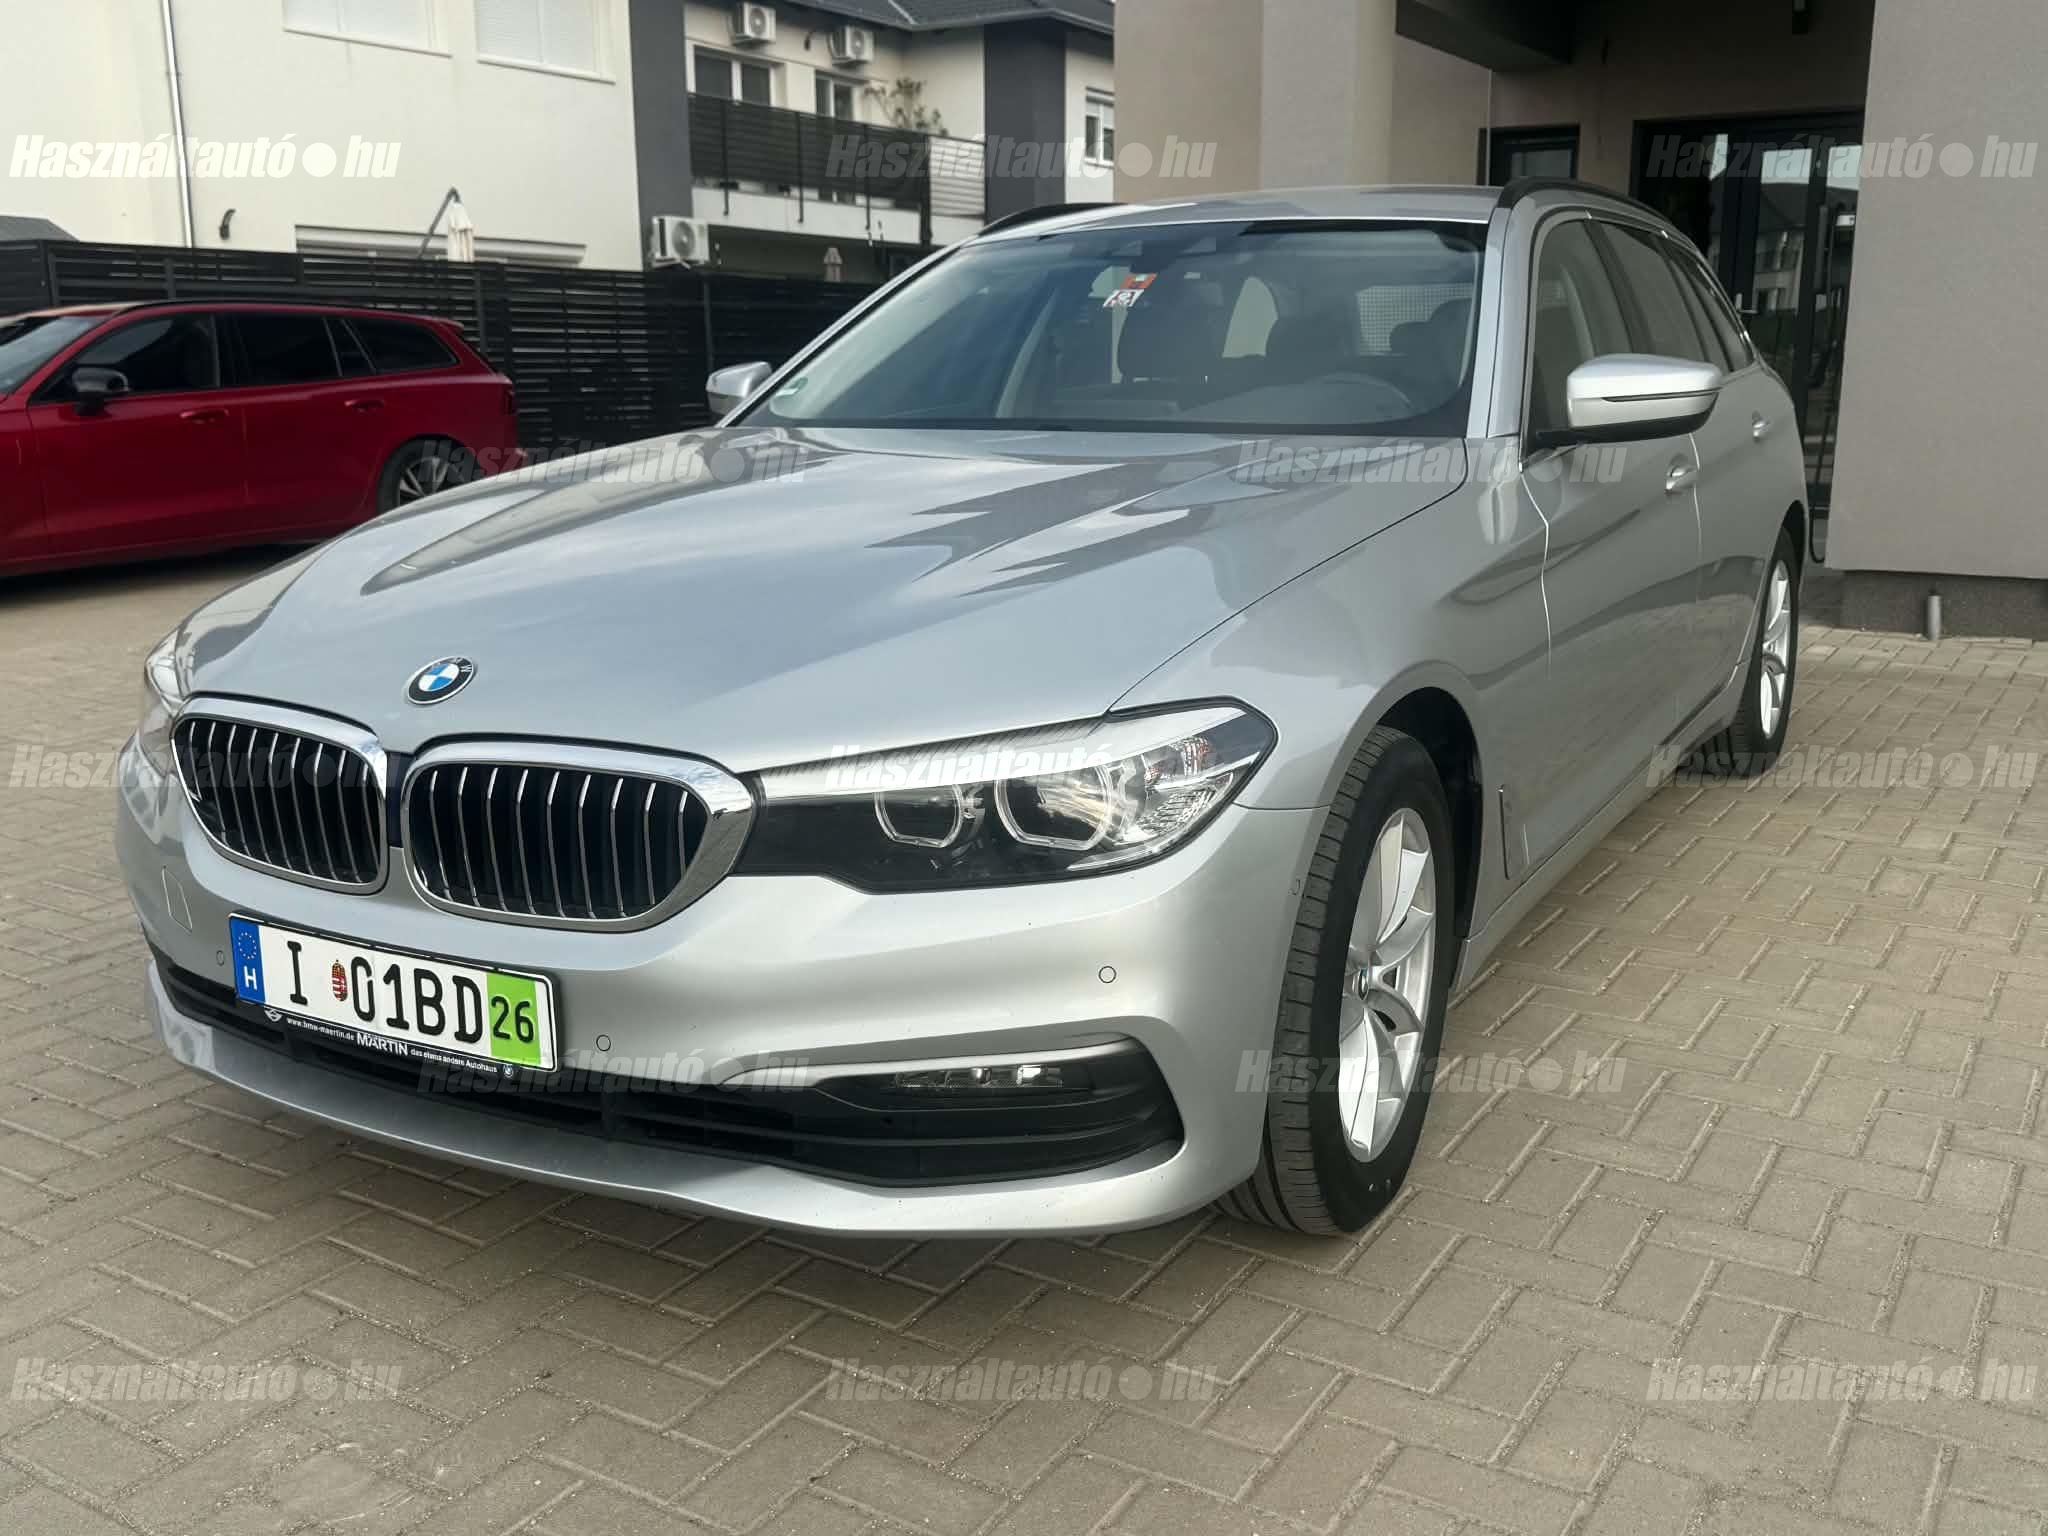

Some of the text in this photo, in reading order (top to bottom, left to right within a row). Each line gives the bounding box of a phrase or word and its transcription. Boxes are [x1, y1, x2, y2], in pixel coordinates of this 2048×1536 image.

[243, 966, 258, 991] H
[286, 940, 308, 1006] I
[490, 995, 535, 1043] 26
[465, 1059, 498, 1073] Autohaus
